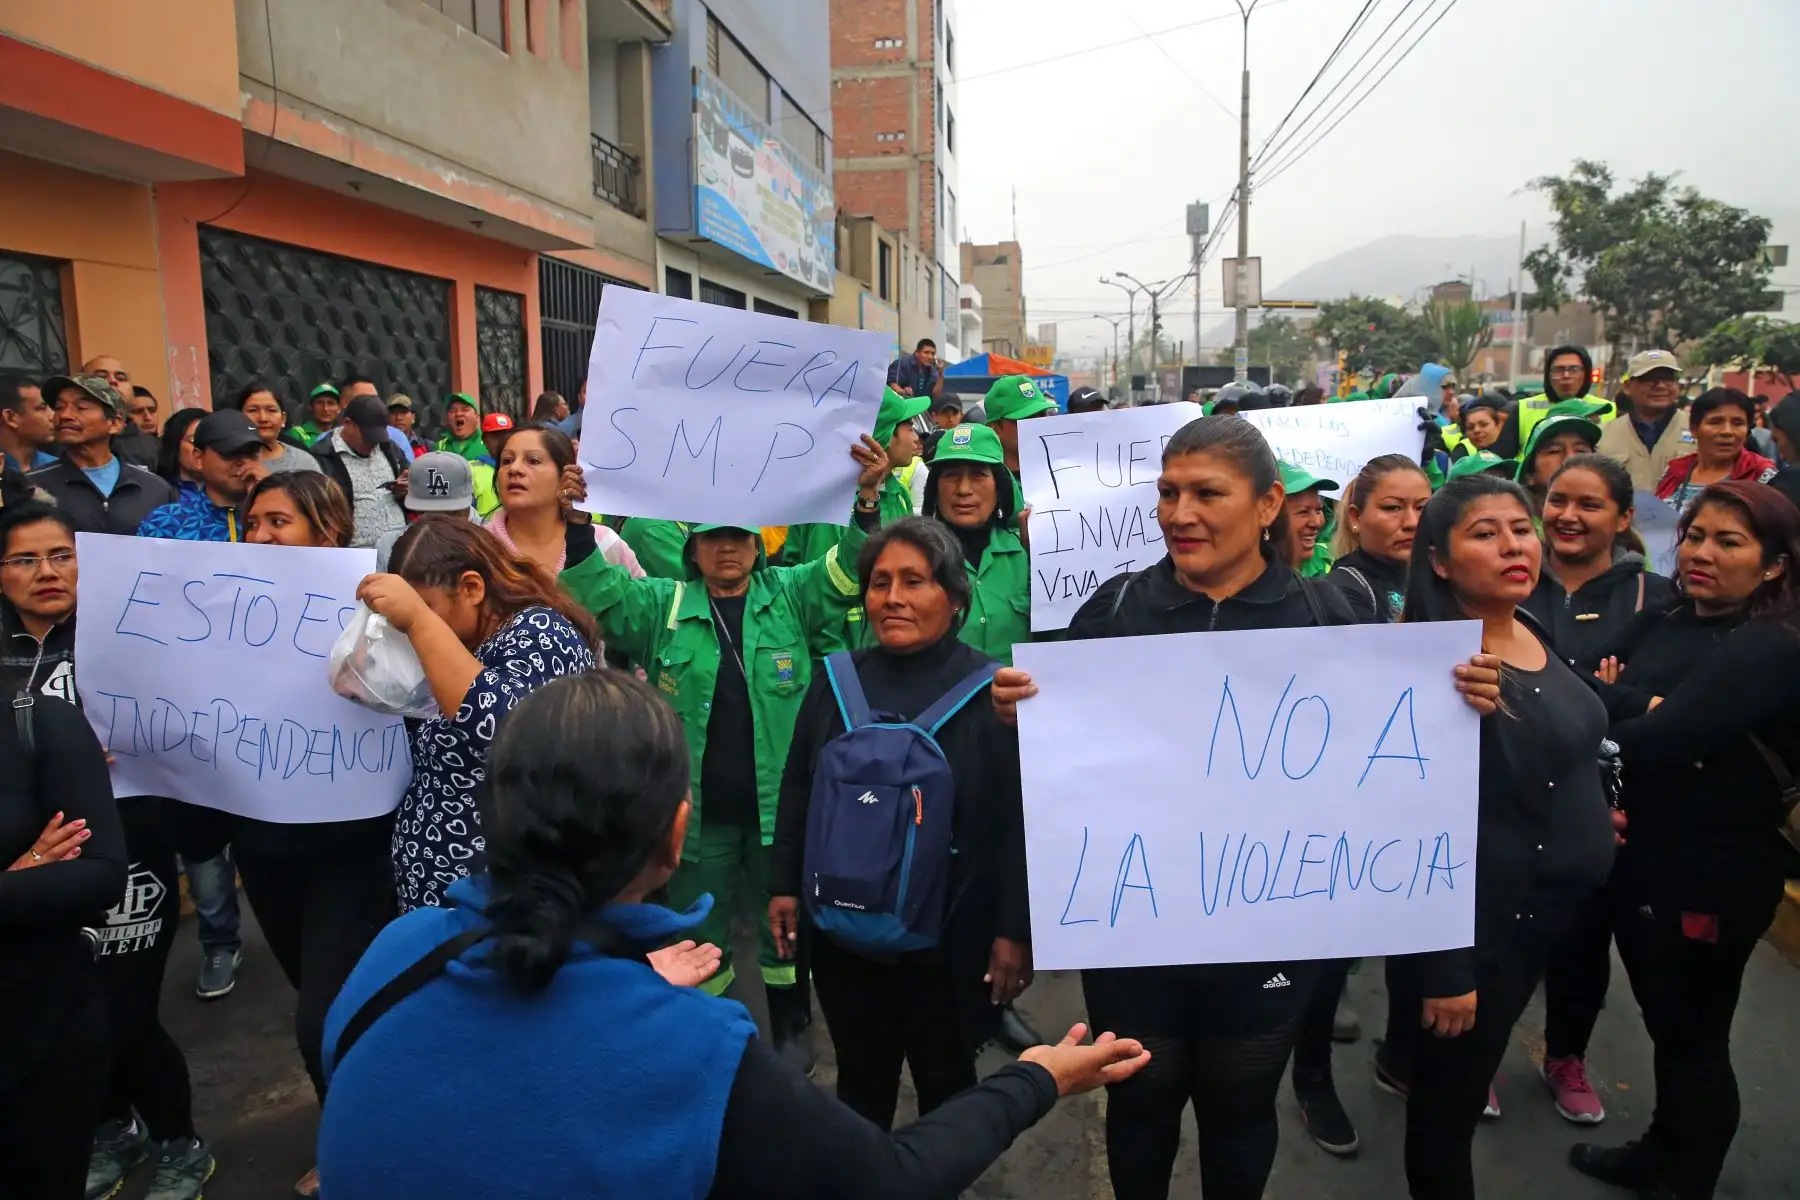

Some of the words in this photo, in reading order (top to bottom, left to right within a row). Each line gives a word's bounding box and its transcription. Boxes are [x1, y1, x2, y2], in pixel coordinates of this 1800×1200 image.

[631, 316, 860, 408] FUERA
[427, 468, 450, 496] LA
[1038, 567, 1099, 602] VIVA
[115, 571, 279, 647] ESTO
[1206, 673, 1330, 780] NO
[1357, 687, 1430, 788] A
[1059, 826, 1158, 928] LA
[1200, 830, 1467, 917] VIOLENCIA
[834, 900, 865, 910] Quechua
[97, 919, 162, 941] HILIPP
[100, 934, 156, 956] LEIN
[1262, 980, 1291, 989] adidas
